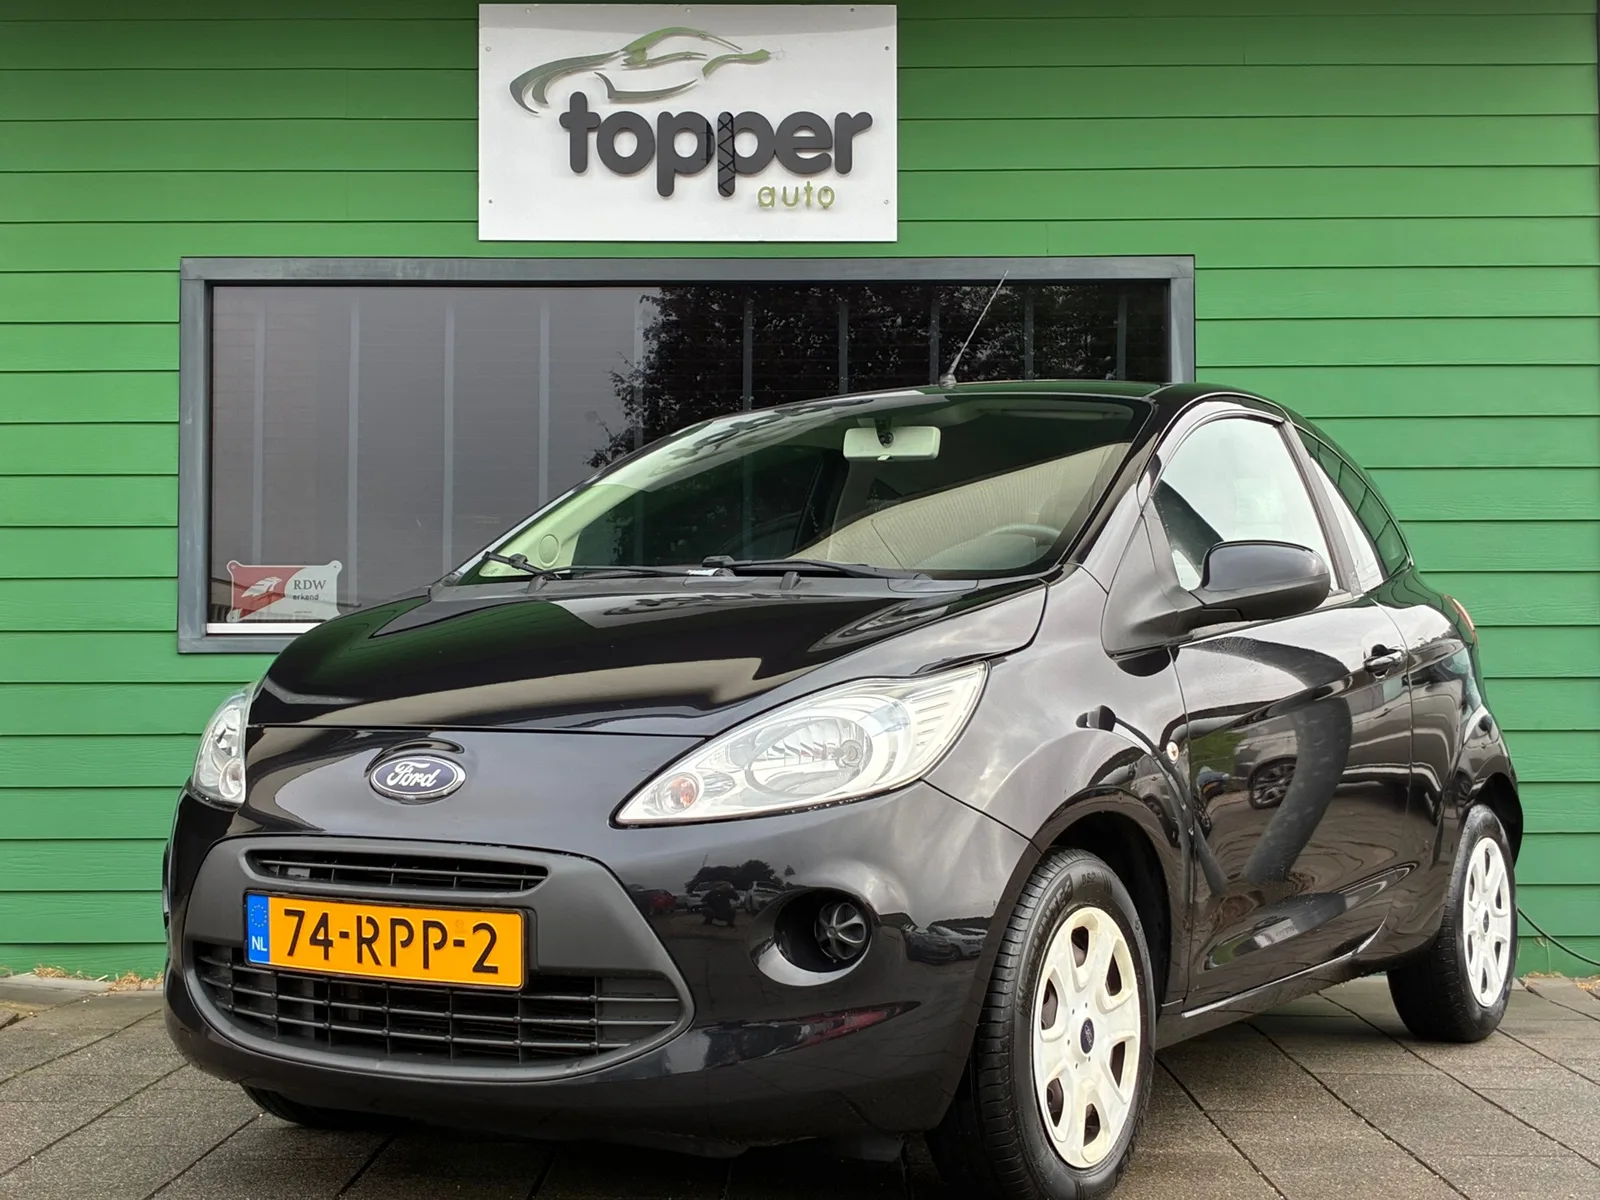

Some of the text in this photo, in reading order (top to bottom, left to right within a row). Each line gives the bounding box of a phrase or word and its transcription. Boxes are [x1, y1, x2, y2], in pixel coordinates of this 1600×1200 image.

[559, 91, 873, 197] topper
[757, 182, 835, 208] auto
[294, 579, 326, 590] RDW
[386, 761, 441, 787] Ford
[252, 935, 267, 952] NL
[283, 908, 499, 974] 74-RPP-2
